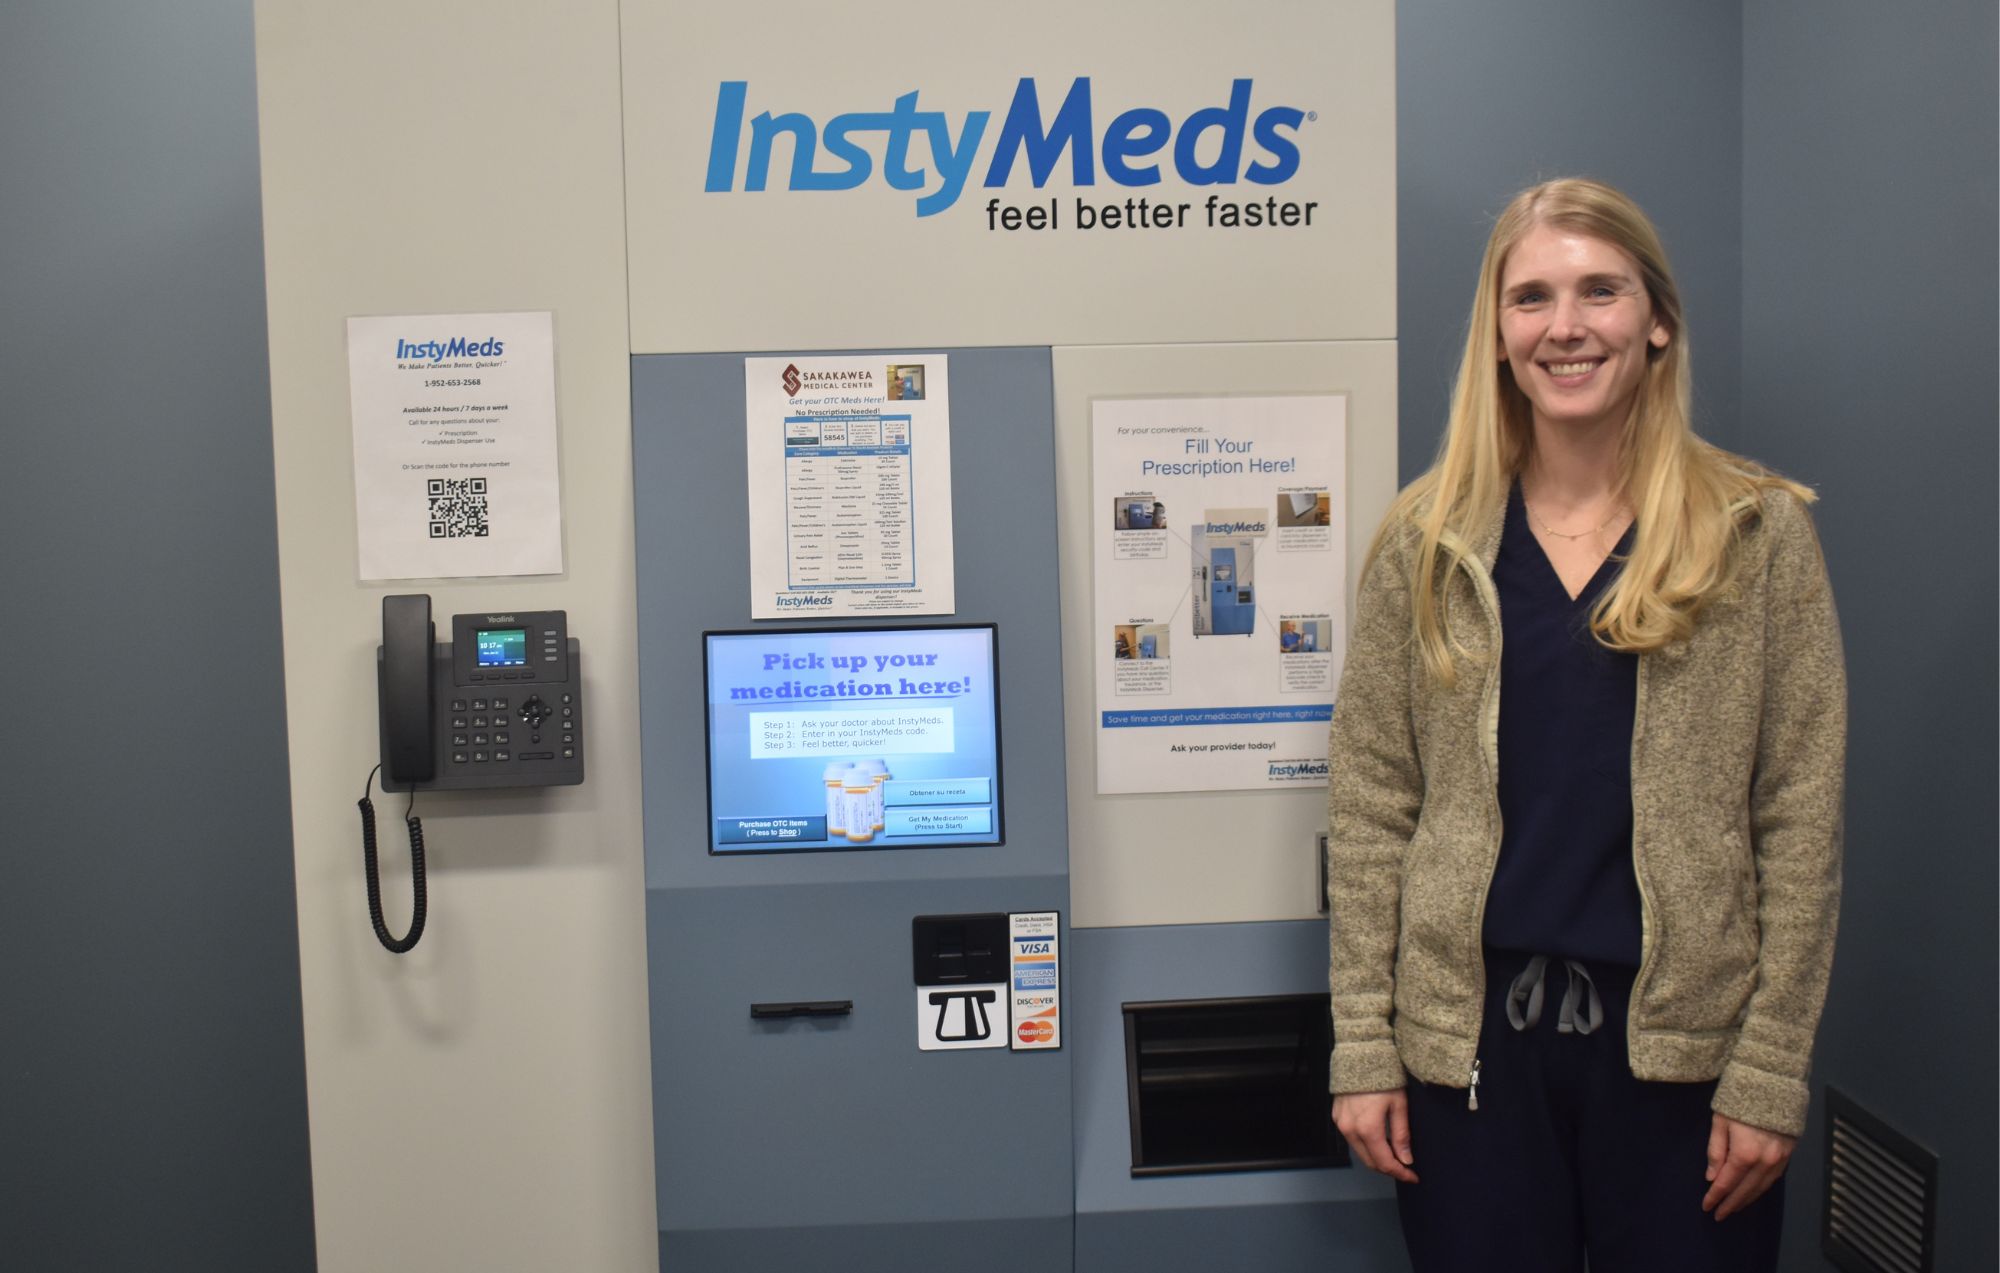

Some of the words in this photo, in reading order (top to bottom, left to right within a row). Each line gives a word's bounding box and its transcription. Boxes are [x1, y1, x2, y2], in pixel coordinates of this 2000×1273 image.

[987, 198, 1058, 231] feel
[1077, 196, 1190, 229] better
[1205, 194, 1319, 227] faster
[396, 337, 504, 362] InstyMeds
[803, 371, 872, 381] SAKAKAWEA
[425, 378, 481, 387] 1-952-653-2568
[804, 398, 822, 407] your
[863, 396, 885, 404] Here!
[808, 408, 849, 417] Prescription
[1132, 427, 1149, 435] your
[1185, 439, 1209, 454] Fill
[1215, 438, 1253, 453] Your
[1142, 460, 1243, 478] Prescription
[1249, 458, 1295, 473] Here!
[1206, 522, 1266, 535] InstyMeds
[776, 595, 832, 607] InstyMeds
[763, 653, 825, 670] Pick
[831, 654, 867, 673] up
[874, 653, 938, 672] your
[730, 679, 892, 699] medication
[899, 677, 971, 695] here!
[1108, 716, 1128, 724] Save
[1169, 714, 1182, 723] get
[1204, 712, 1251, 720] medication
[1253, 711, 1271, 720] right
[1295, 710, 1313, 718] right
[764, 722, 784, 730] Step
[802, 720, 817, 728] Ask
[820, 720, 840, 728] your
[842, 719, 868, 727] doctor
[871, 718, 895, 726] about
[764, 732, 784, 740] Step
[802, 730, 824, 738] Enter
[839, 730, 857, 738] your
[860, 728, 903, 737] InstyMeds
[764, 741, 784, 750] Step
[802, 740, 820, 748] Feel
[822, 740, 850, 748] better,
[852, 739, 886, 748] quicker!
[1171, 744, 1186, 752] Ask
[1189, 744, 1208, 753] your
[1210, 743, 1245, 752] provider
[1248, 741, 1276, 750] today!
[739, 820, 771, 828] Purchase
[915, 823, 935, 831] (Press
[779, 828, 797, 836] Shop
[1021, 944, 1049, 954] VISA
[1015, 970, 1054, 978] AMERICAN
[1019, 1028, 1053, 1036] MasterCard
